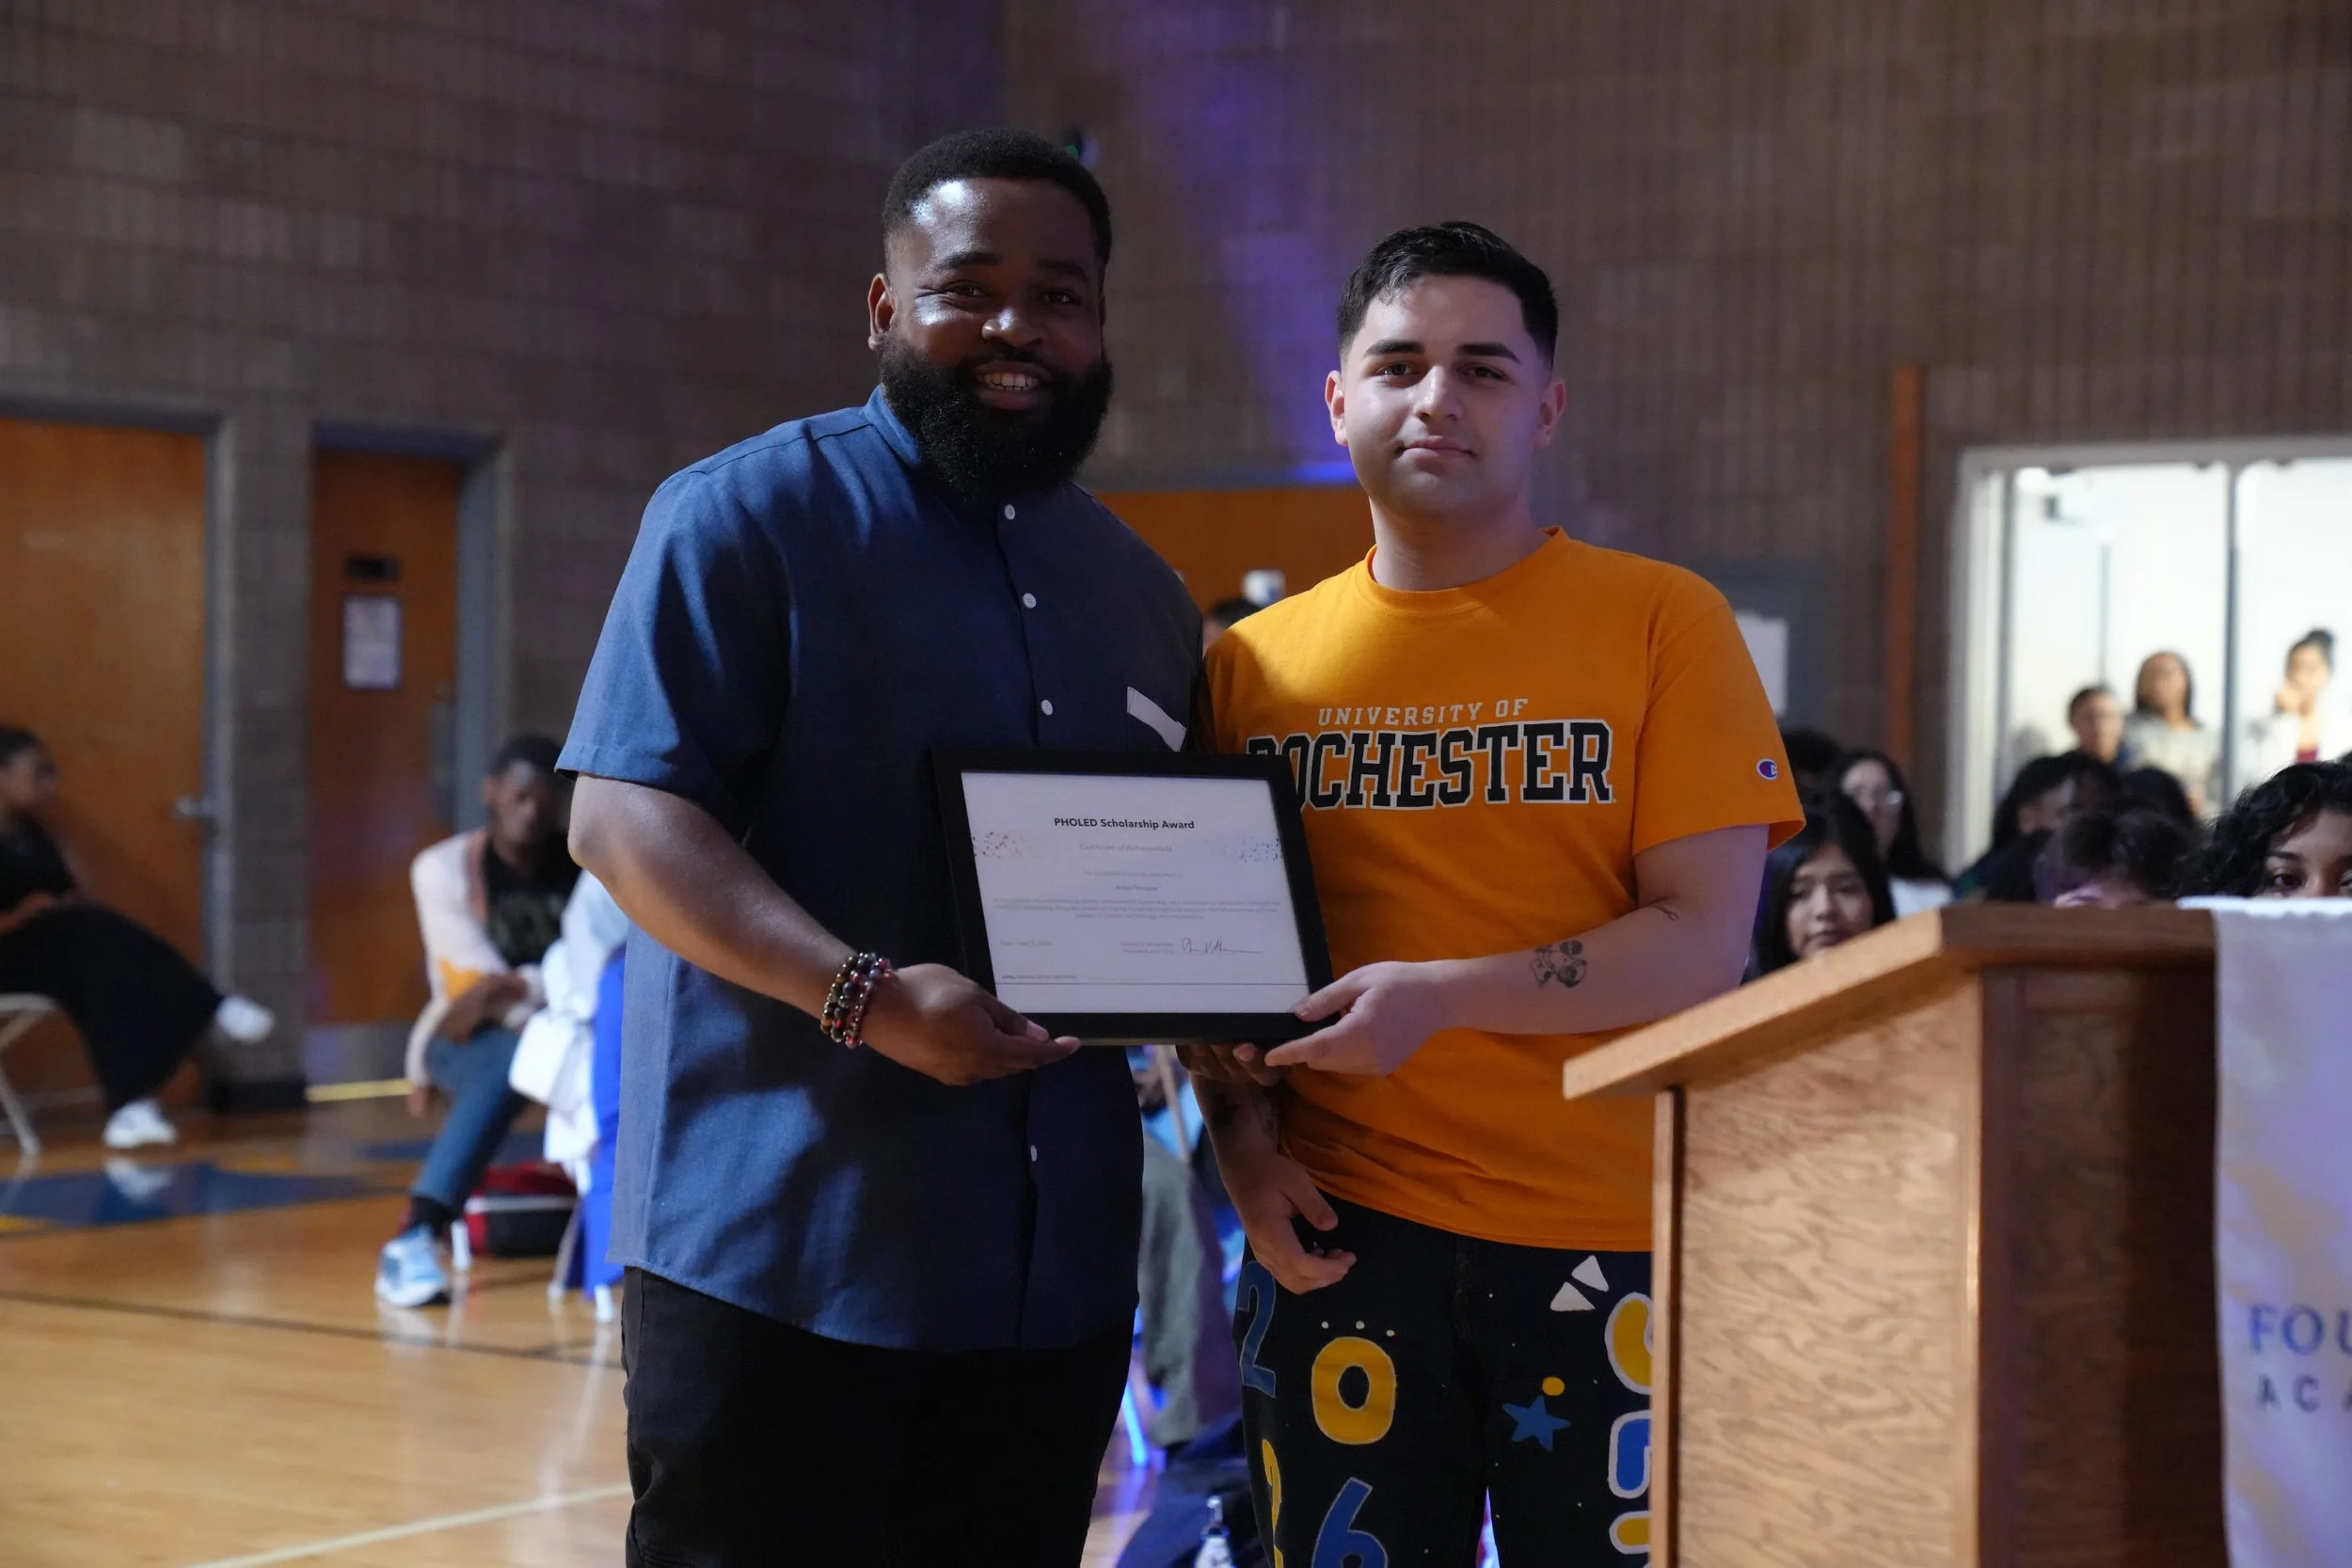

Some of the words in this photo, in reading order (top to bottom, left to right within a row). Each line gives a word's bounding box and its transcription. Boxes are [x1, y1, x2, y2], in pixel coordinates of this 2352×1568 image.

[1318, 702, 1483, 726] UNIVERSITY
[1495, 698, 1529, 718] OF
[1247, 719, 1614, 811] OCHESTER
[1054, 817, 1098, 827] PHOLED
[1100, 818, 1159, 831] Scholarship
[1162, 820, 1195, 829] Award
